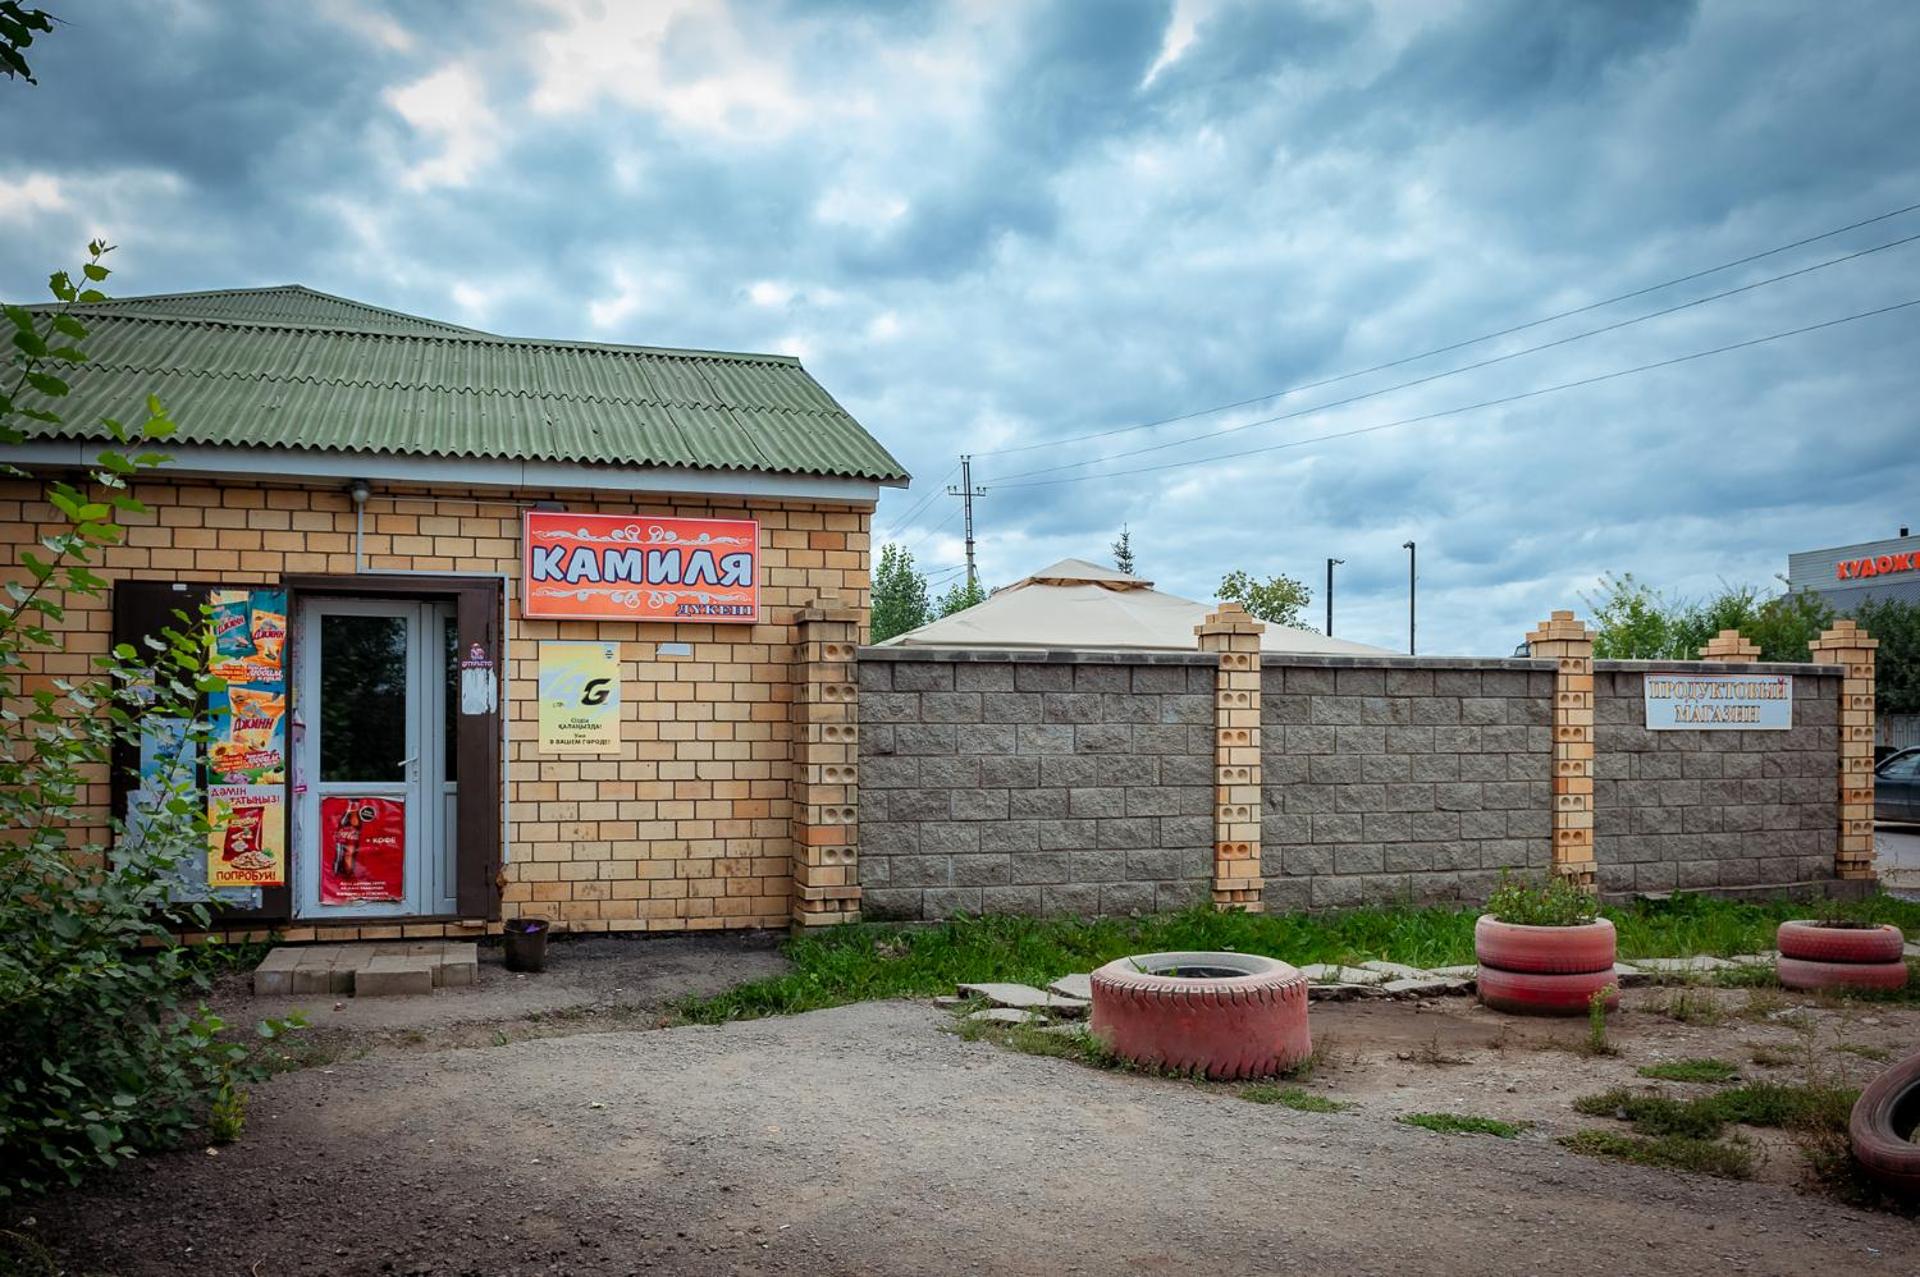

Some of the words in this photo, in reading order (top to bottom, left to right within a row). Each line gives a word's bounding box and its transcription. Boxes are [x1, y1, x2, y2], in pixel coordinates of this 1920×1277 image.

[531, 544, 753, 587] КАМИЛЯ
[1648, 679, 1788, 702] ПРОДУКТОВЫЙ
[1674, 705, 1760, 723] МАГАЗИН
[215, 871, 276, 881] ПОПРОБУЙ!
